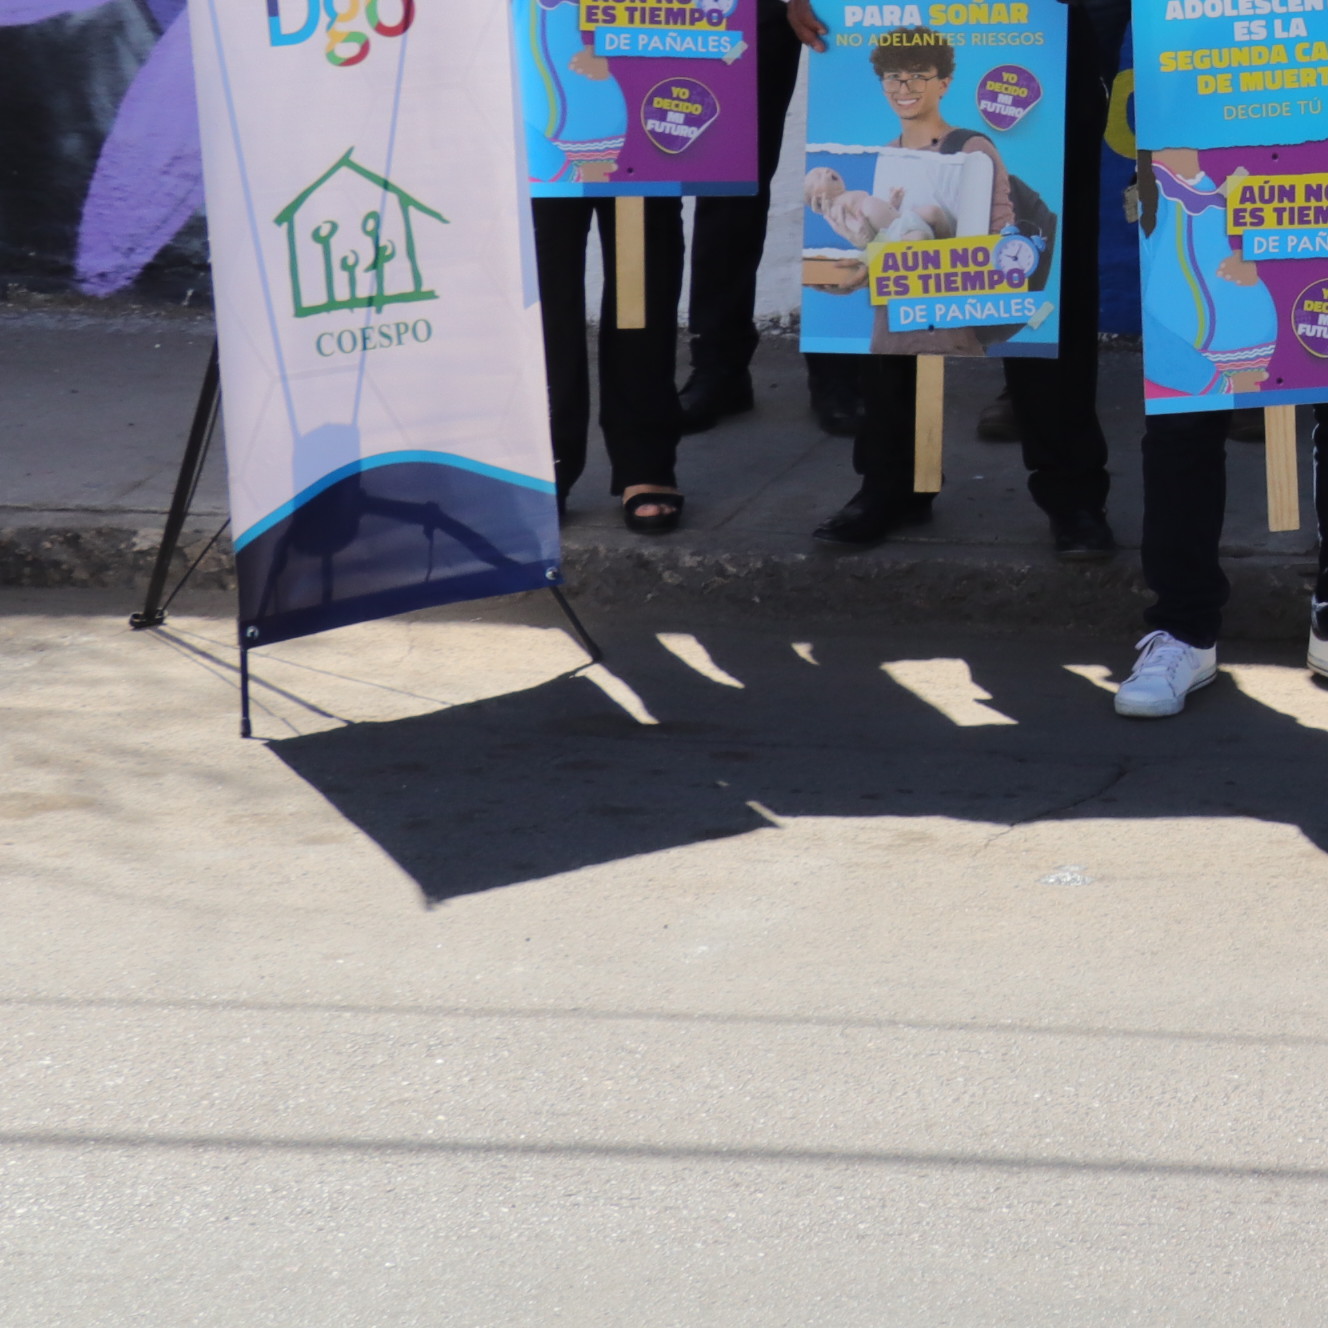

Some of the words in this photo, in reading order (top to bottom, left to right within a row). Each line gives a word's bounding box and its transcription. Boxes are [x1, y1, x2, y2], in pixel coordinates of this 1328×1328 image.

[835, 33, 862, 47] NO
[867, 33, 965, 46] ADELANTES
[970, 32, 1044, 46] RIESGOS
[1233, 20, 1268, 42] ES
[1273, 17, 1307, 39] LA
[1159, 43, 1288, 73] SEGUNDA
[1196, 73, 1233, 95] DE
[1238, 180, 1297, 208] AÚN
[315, 318, 432, 357] COESPO
